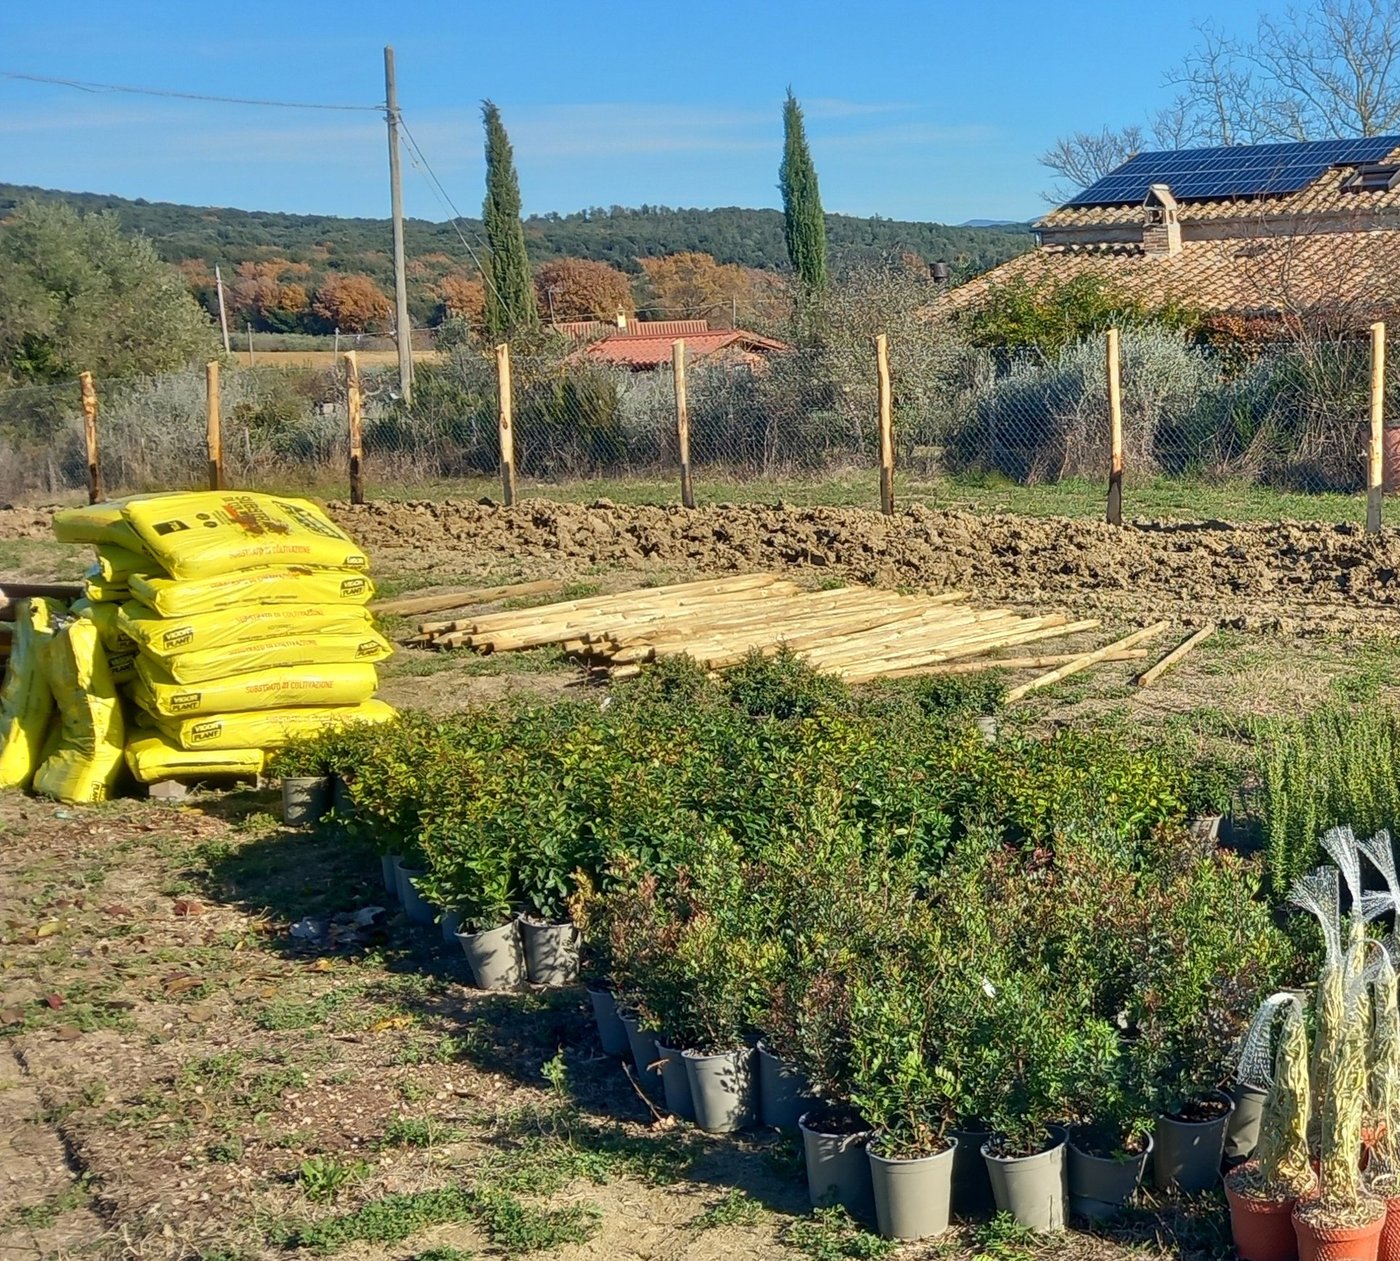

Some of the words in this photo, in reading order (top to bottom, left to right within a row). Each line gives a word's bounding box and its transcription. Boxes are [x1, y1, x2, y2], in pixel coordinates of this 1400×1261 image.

[343, 587, 362, 595] PLANT
[166, 627, 193, 640] VIGOR
[166, 636, 190, 648] PLANT
[173, 694, 198, 703] VIGOR
[173, 702, 197, 711] PLANT
[195, 721, 220, 732] VIGOR
[194, 730, 218, 741] PLANT
